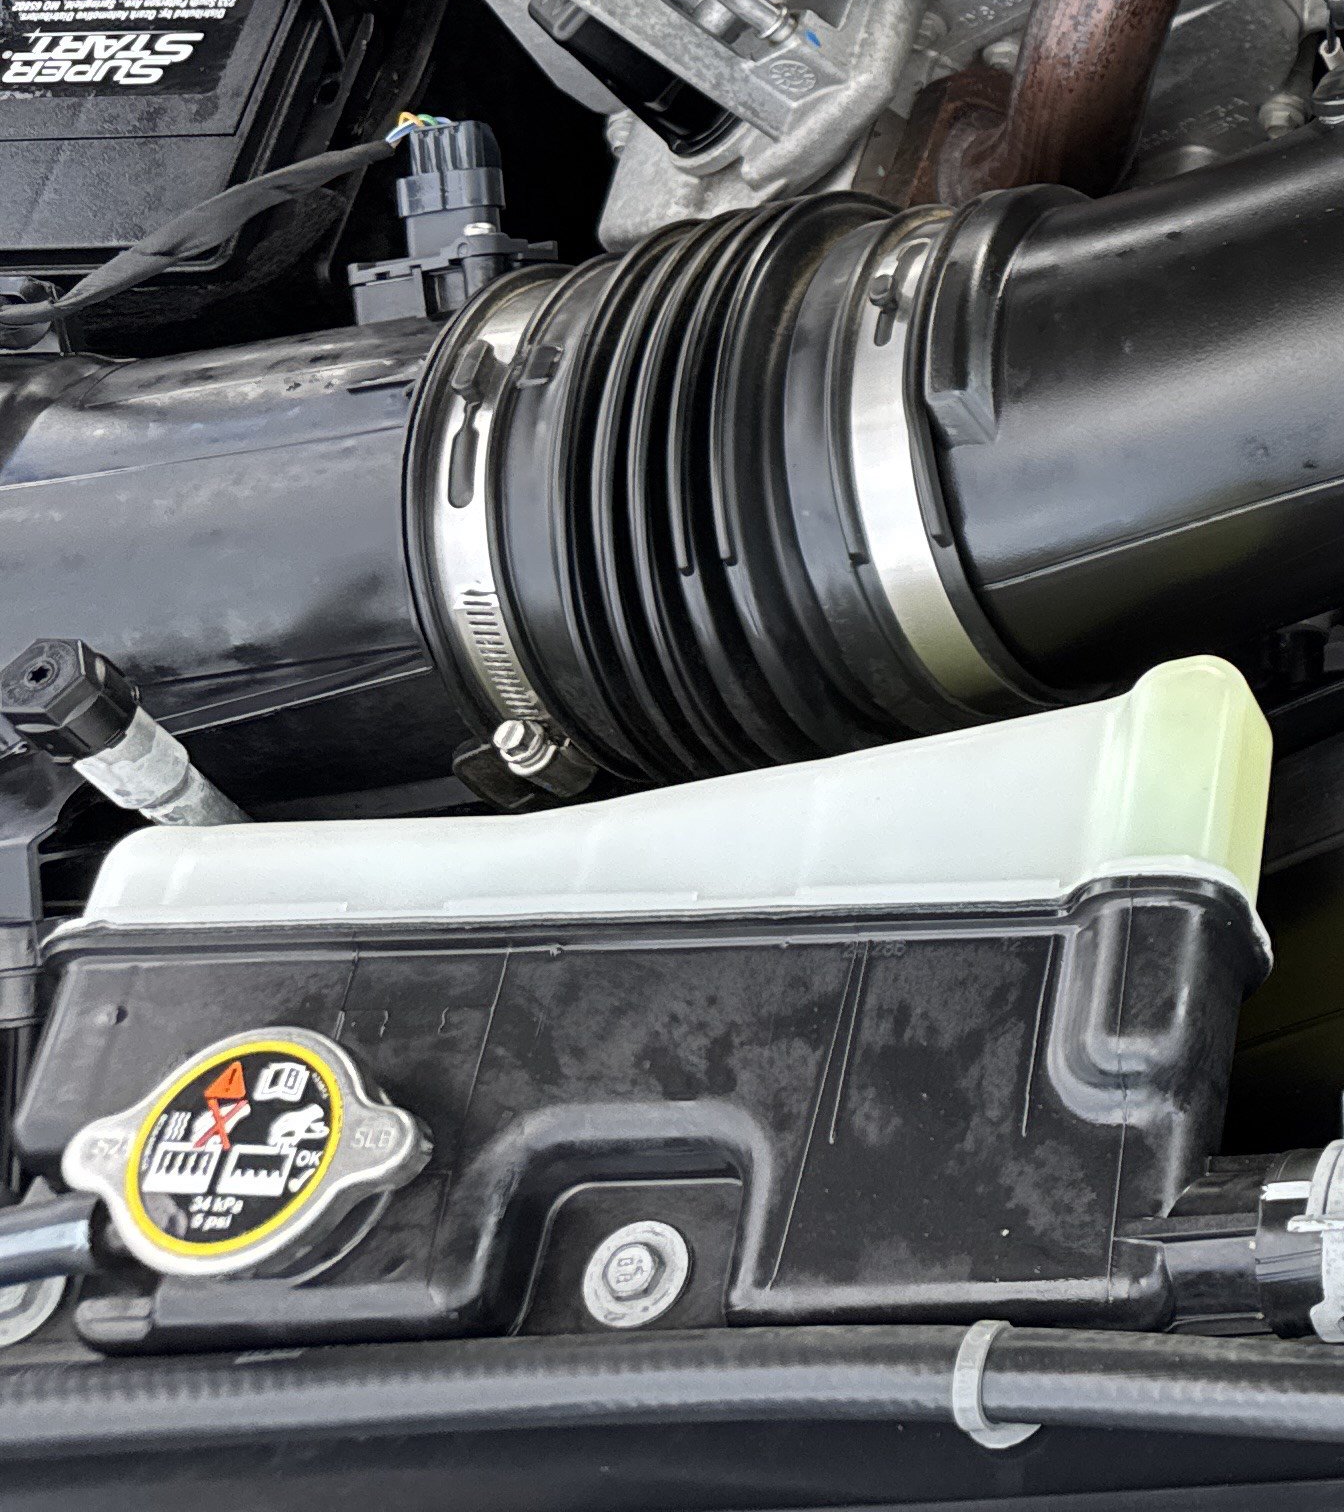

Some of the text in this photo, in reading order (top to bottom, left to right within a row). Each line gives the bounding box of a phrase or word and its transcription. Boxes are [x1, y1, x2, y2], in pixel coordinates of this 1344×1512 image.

[2, 57, 173, 85] SUPER
[296, 1149, 324, 1167] OK
[213, 1195, 245, 1215] kPa
[202, 1212, 233, 1232] psi
